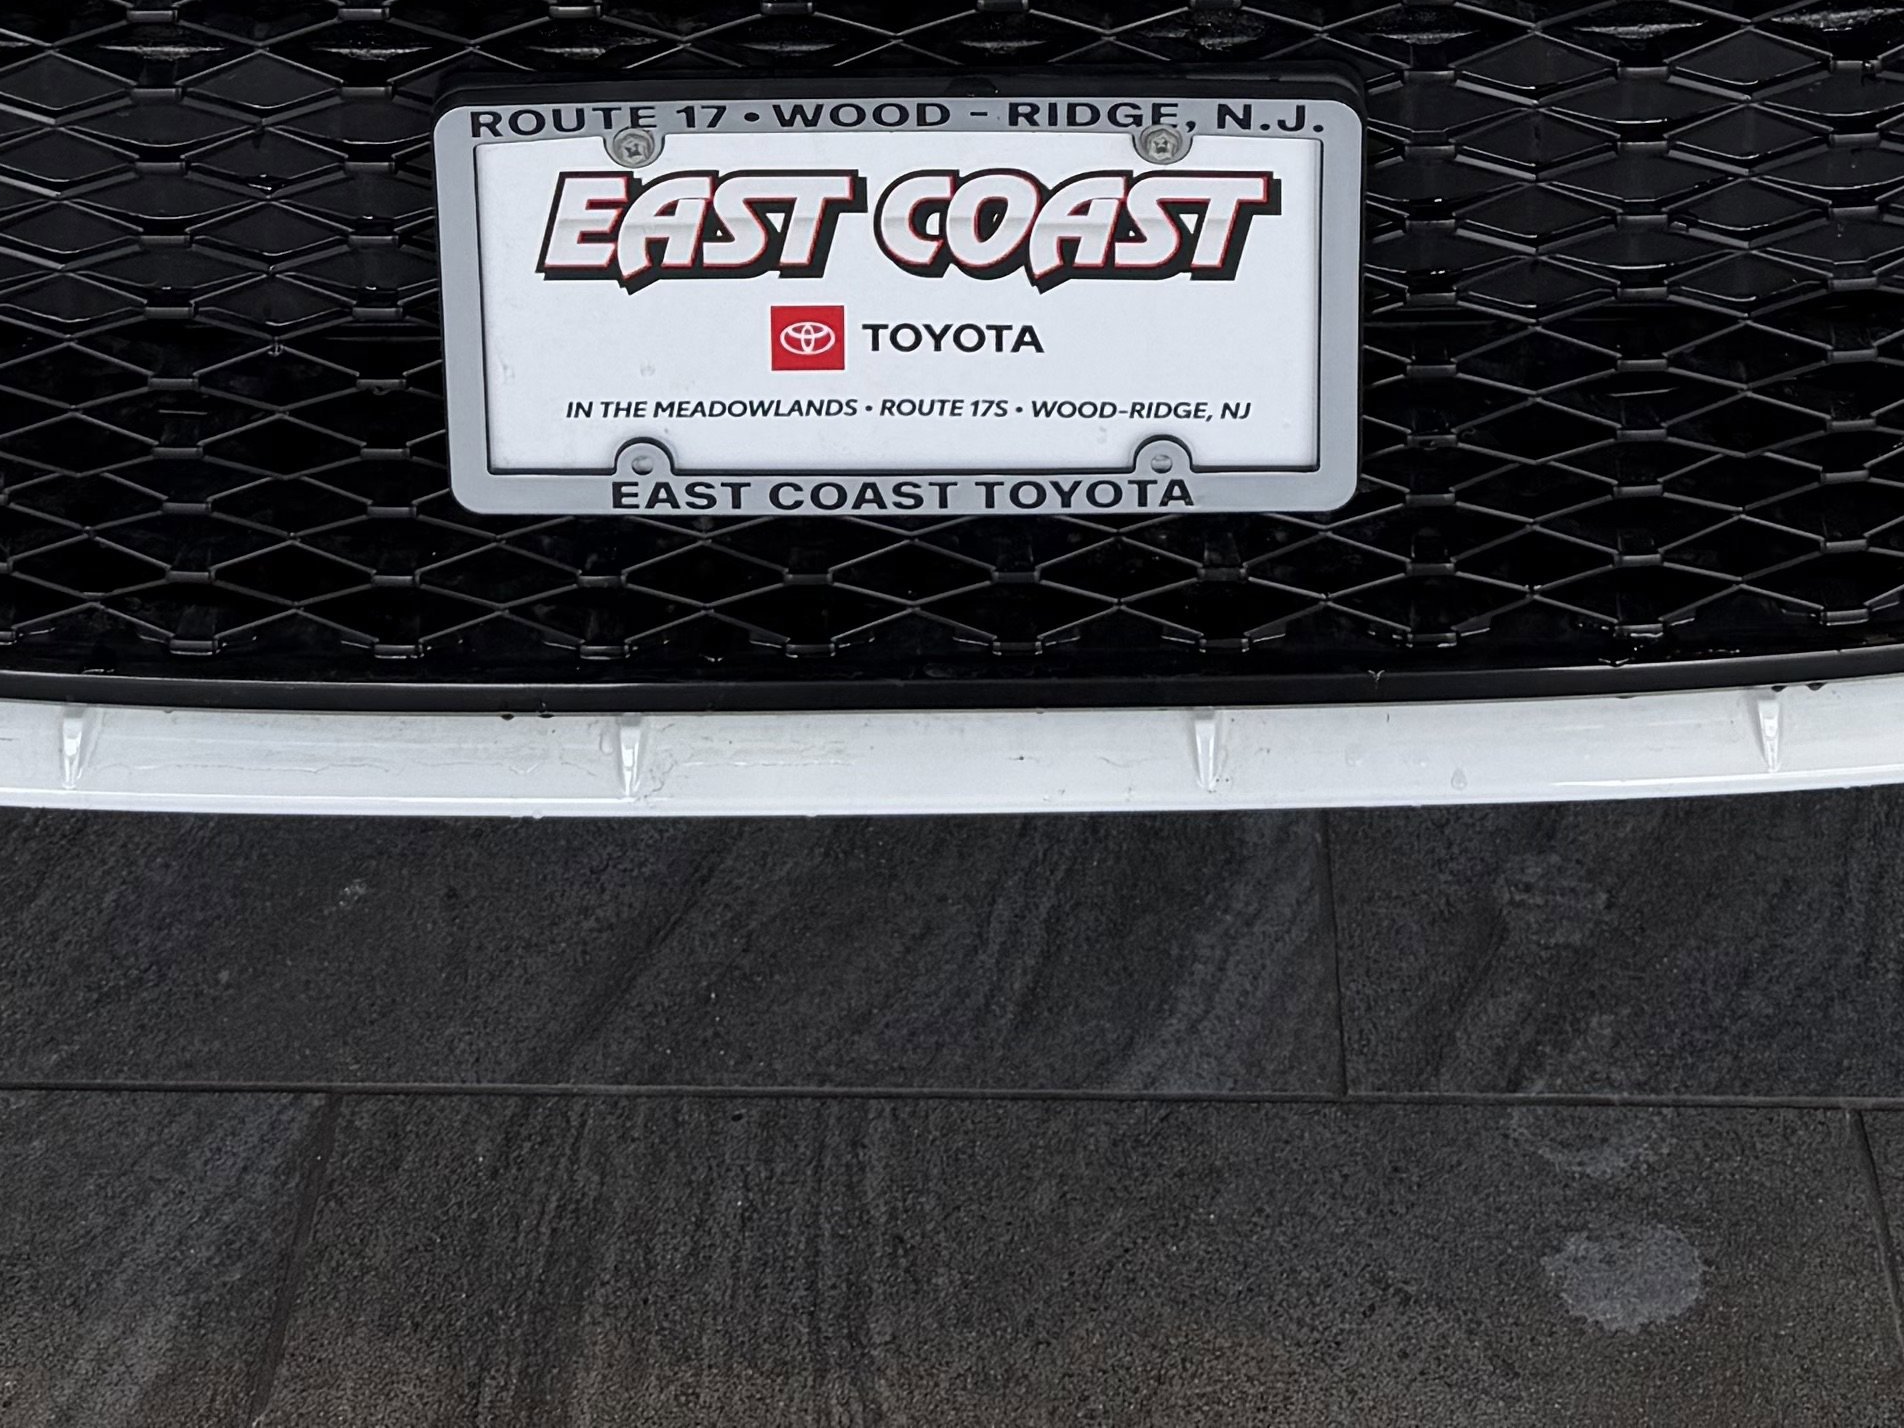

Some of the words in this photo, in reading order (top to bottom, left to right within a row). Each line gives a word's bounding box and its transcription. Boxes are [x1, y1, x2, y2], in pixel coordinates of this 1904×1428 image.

[470, 105, 657, 138] ROUTE
[677, 104, 727, 129] 17
[772, 102, 951, 129] WOOD
[1007, 101, 1197, 134] RIDGE,
[1216, 103, 1324, 133] N.J.
[535, 168, 868, 295] EAST
[873, 168, 1282, 295] COAST
[862, 322, 1045, 354] TOYOTA
[565, 401, 594, 419] IN
[600, 400, 647, 418] THE
[652, 399, 859, 418] MEADOWLANDS
[879, 399, 964, 417] ROUTE
[970, 399, 1009, 417] 17S
[1031, 400, 1214, 422] WOOD-RIDGE,
[1220, 402, 1251, 420] NJ
[612, 480, 751, 510] EAST
[768, 480, 958, 511] COAST
[974, 479, 1195, 510] TOYOTA
